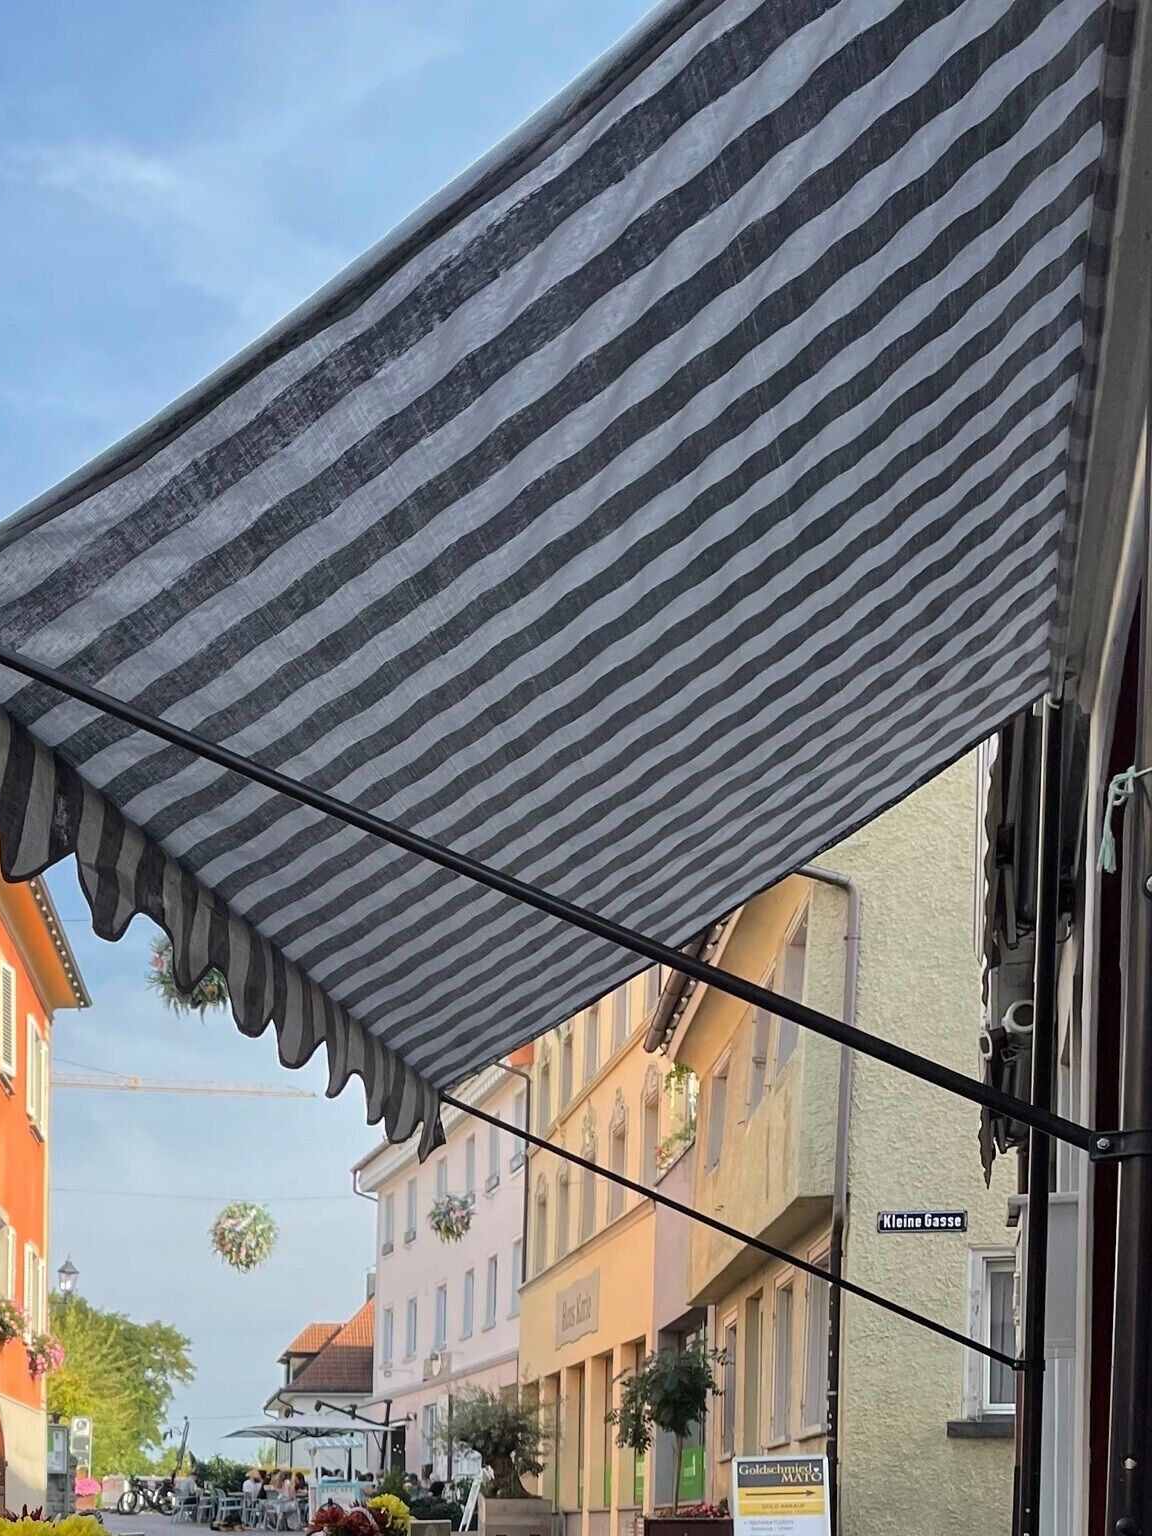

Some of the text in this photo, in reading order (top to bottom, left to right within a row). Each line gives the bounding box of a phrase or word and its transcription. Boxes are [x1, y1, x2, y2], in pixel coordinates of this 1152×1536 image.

[883, 1213, 962, 1229] Kleine Gasse
[739, 1463, 812, 1476] Goldschmied
